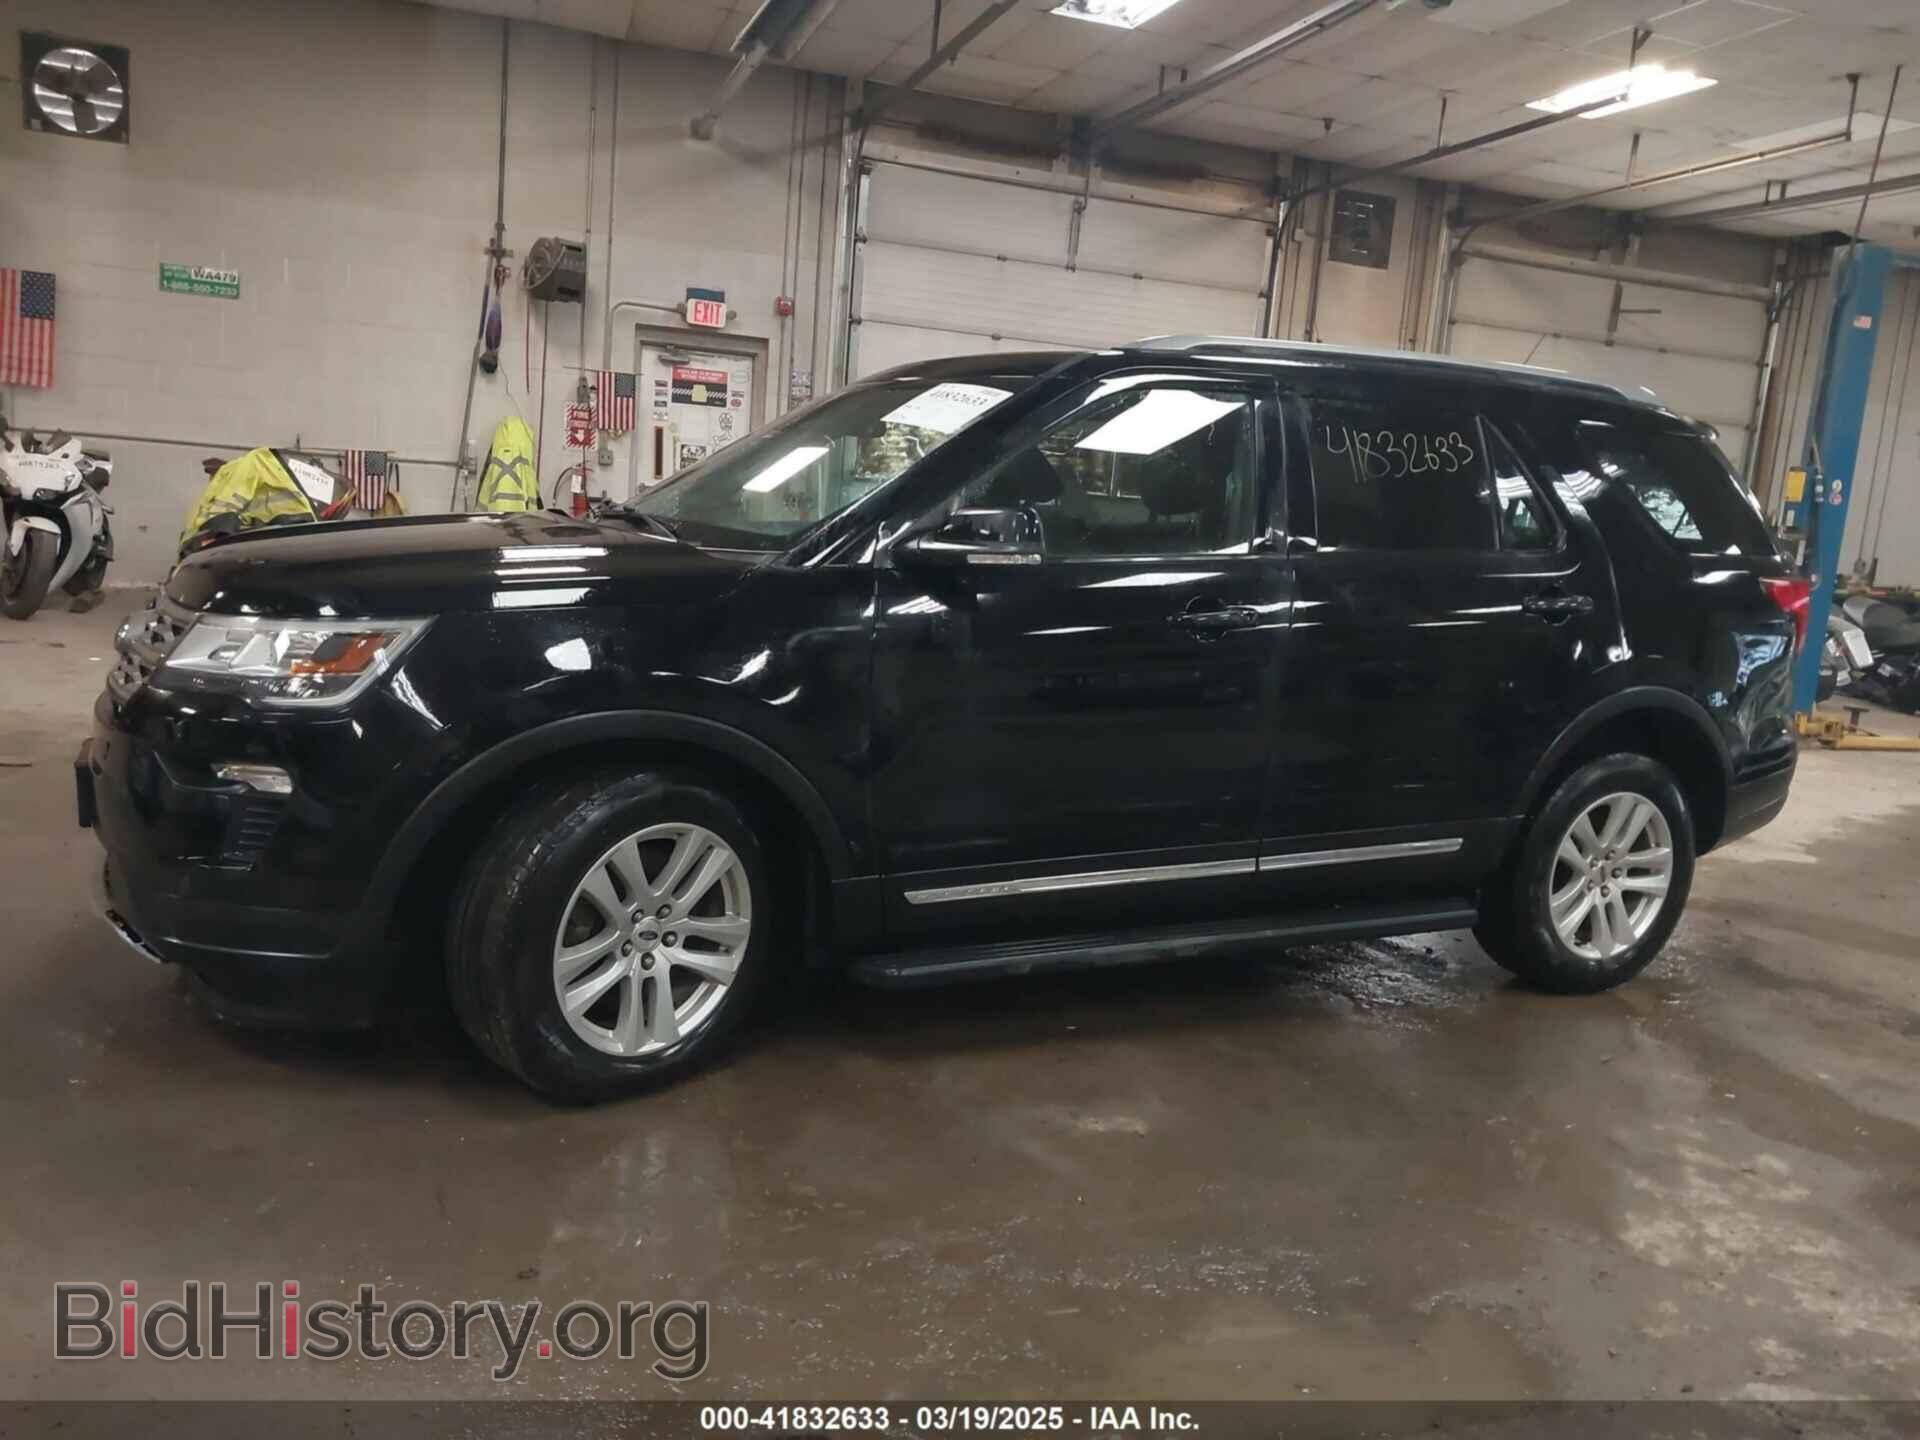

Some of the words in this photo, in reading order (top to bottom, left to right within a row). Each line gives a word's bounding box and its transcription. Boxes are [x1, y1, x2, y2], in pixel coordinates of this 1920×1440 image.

[192, 268, 238, 283] WA479
[694, 301, 722, 325] EXIT
[1326, 425, 1474, 484] 41832633
